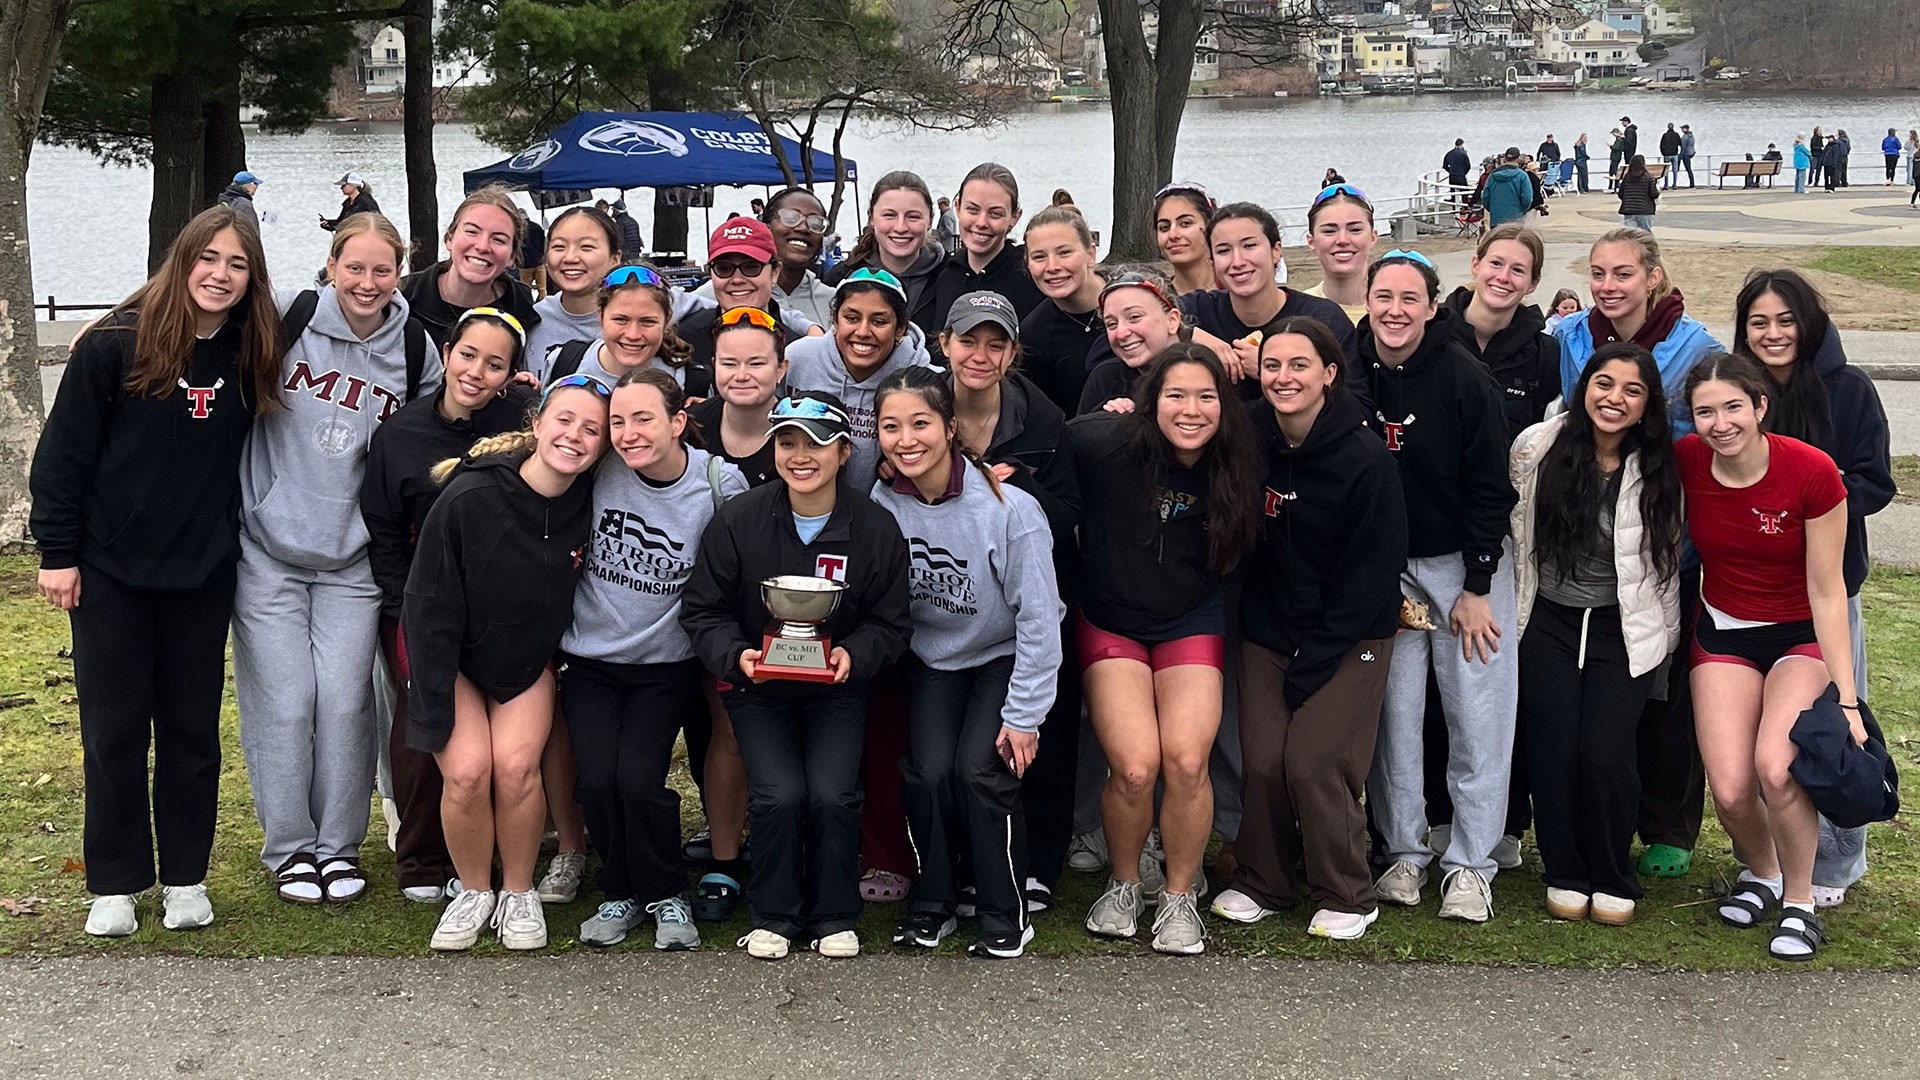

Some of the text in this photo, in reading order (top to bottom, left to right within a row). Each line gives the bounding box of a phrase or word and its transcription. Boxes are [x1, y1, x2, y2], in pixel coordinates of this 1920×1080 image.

[690, 127, 771, 145] COLBY
[723, 226, 753, 238] MIT
[187, 388, 215, 418] T
[284, 361, 401, 424] MIT
[1760, 513, 1781, 534] T
[590, 541, 688, 581] LEAGUE
[591, 529, 692, 573] PATRIOT
[818, 557, 844, 581] T
[775, 643, 788, 651] BC
[801, 645, 819, 653] MIT
[787, 654, 805, 662] CUP
